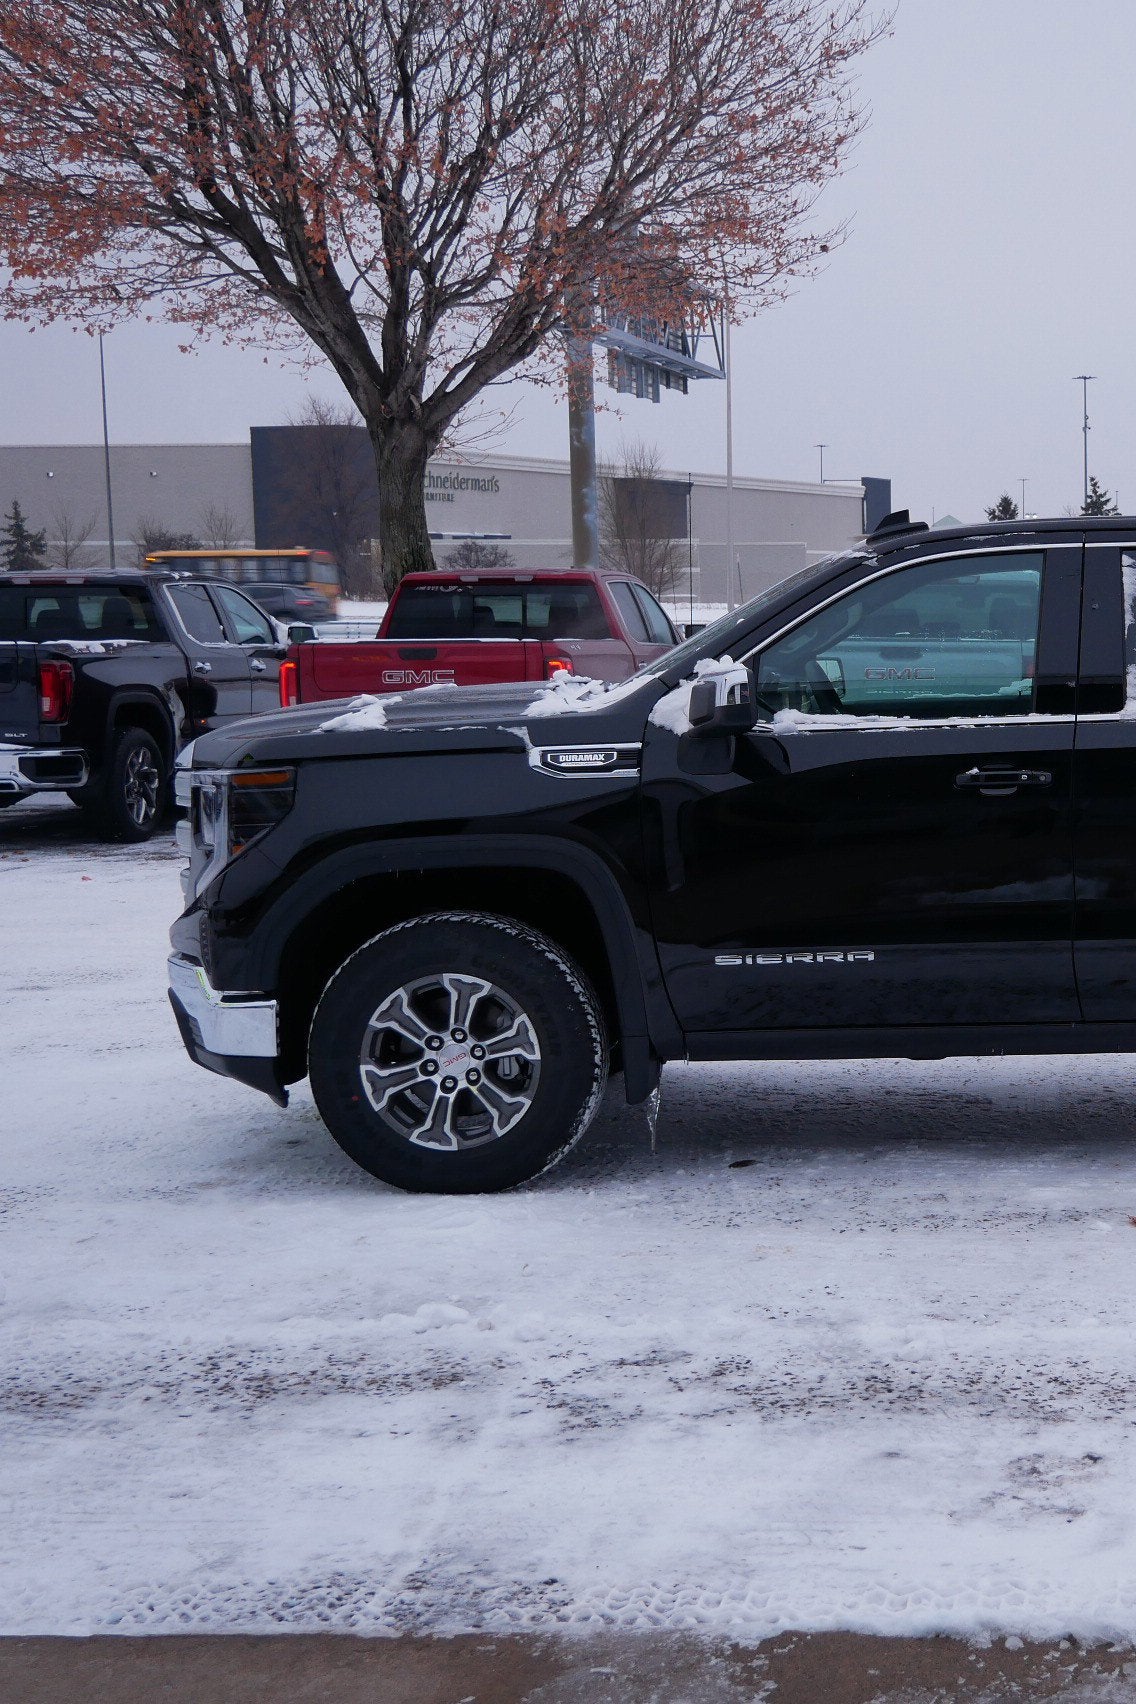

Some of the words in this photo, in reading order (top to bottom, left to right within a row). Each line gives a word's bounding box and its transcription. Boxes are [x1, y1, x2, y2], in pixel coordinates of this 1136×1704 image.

[424, 470, 500, 493] chneiderman's
[425, 492, 455, 502] RNITURE
[382, 670, 455, 684] GMC
[864, 667, 936, 681] GMC
[559, 753, 605, 762] DURAMAX
[714, 950, 875, 966] SIERRA
[442, 1052, 467, 1068] GMC
